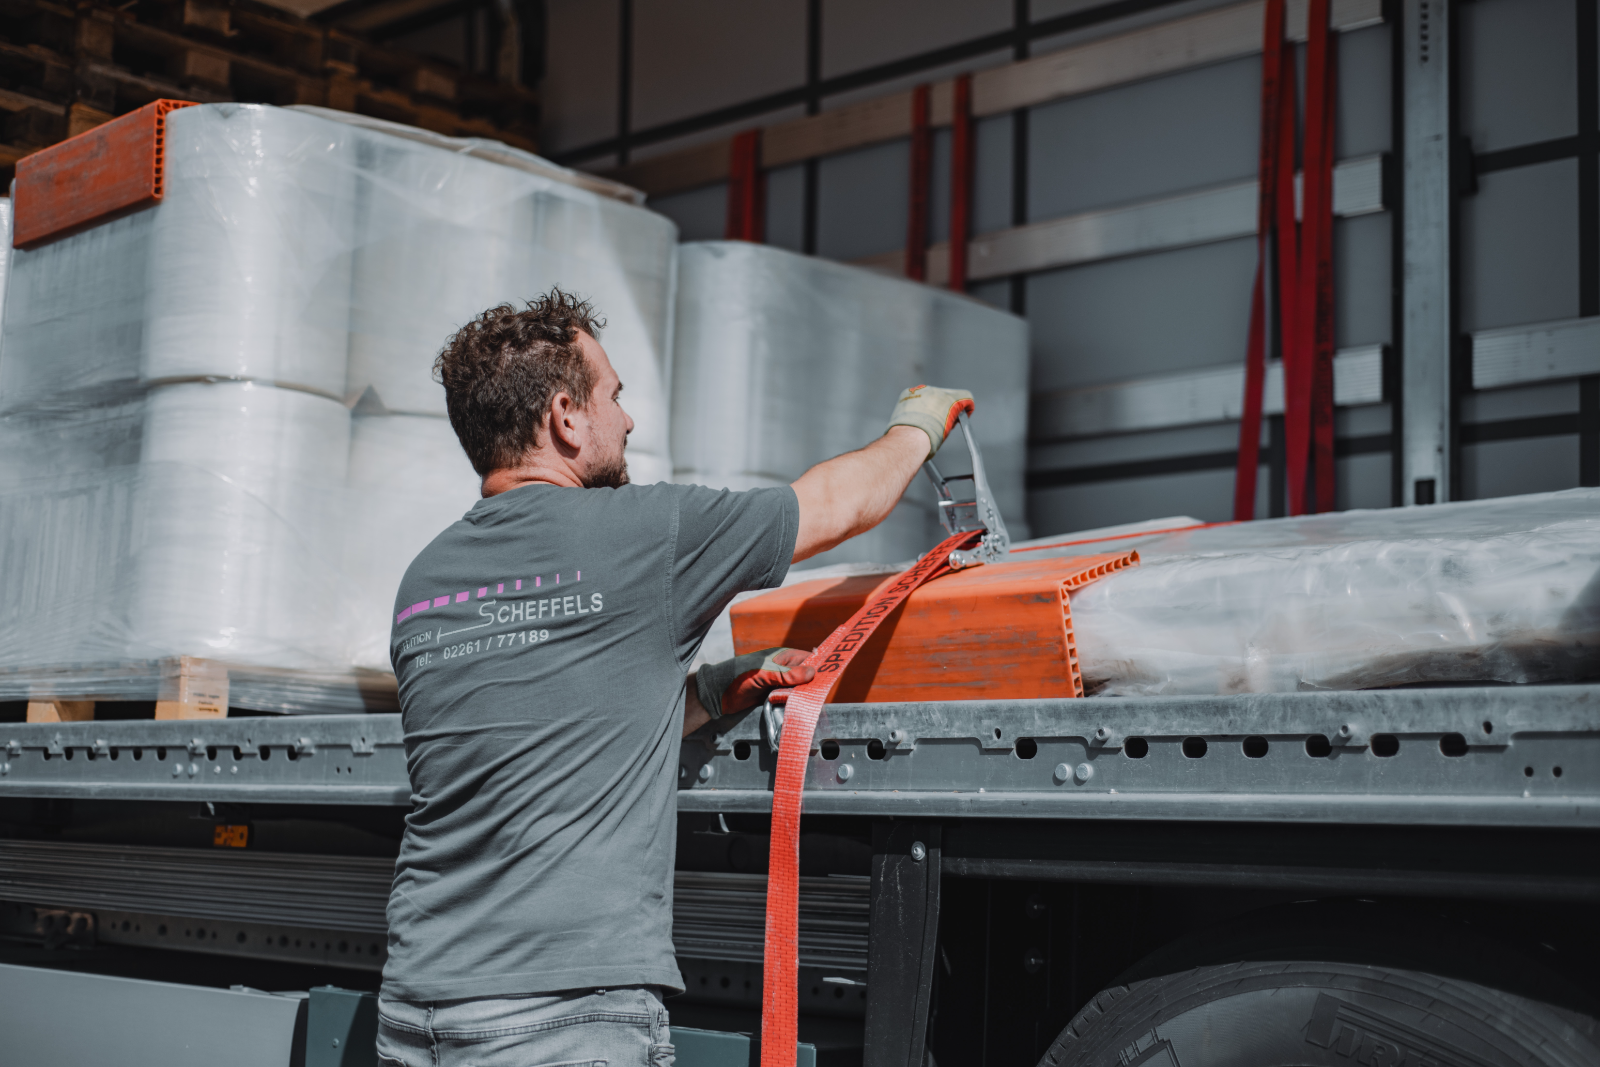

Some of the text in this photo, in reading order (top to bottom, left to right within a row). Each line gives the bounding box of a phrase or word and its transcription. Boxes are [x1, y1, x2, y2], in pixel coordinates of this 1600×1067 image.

[474, 592, 604, 627] SCHEFFELS
[415, 652, 432, 668] Tel:
[443, 640, 481, 660] 02261
[498, 629, 549, 648] 77189
[817, 595, 899, 673] SPEDITION
